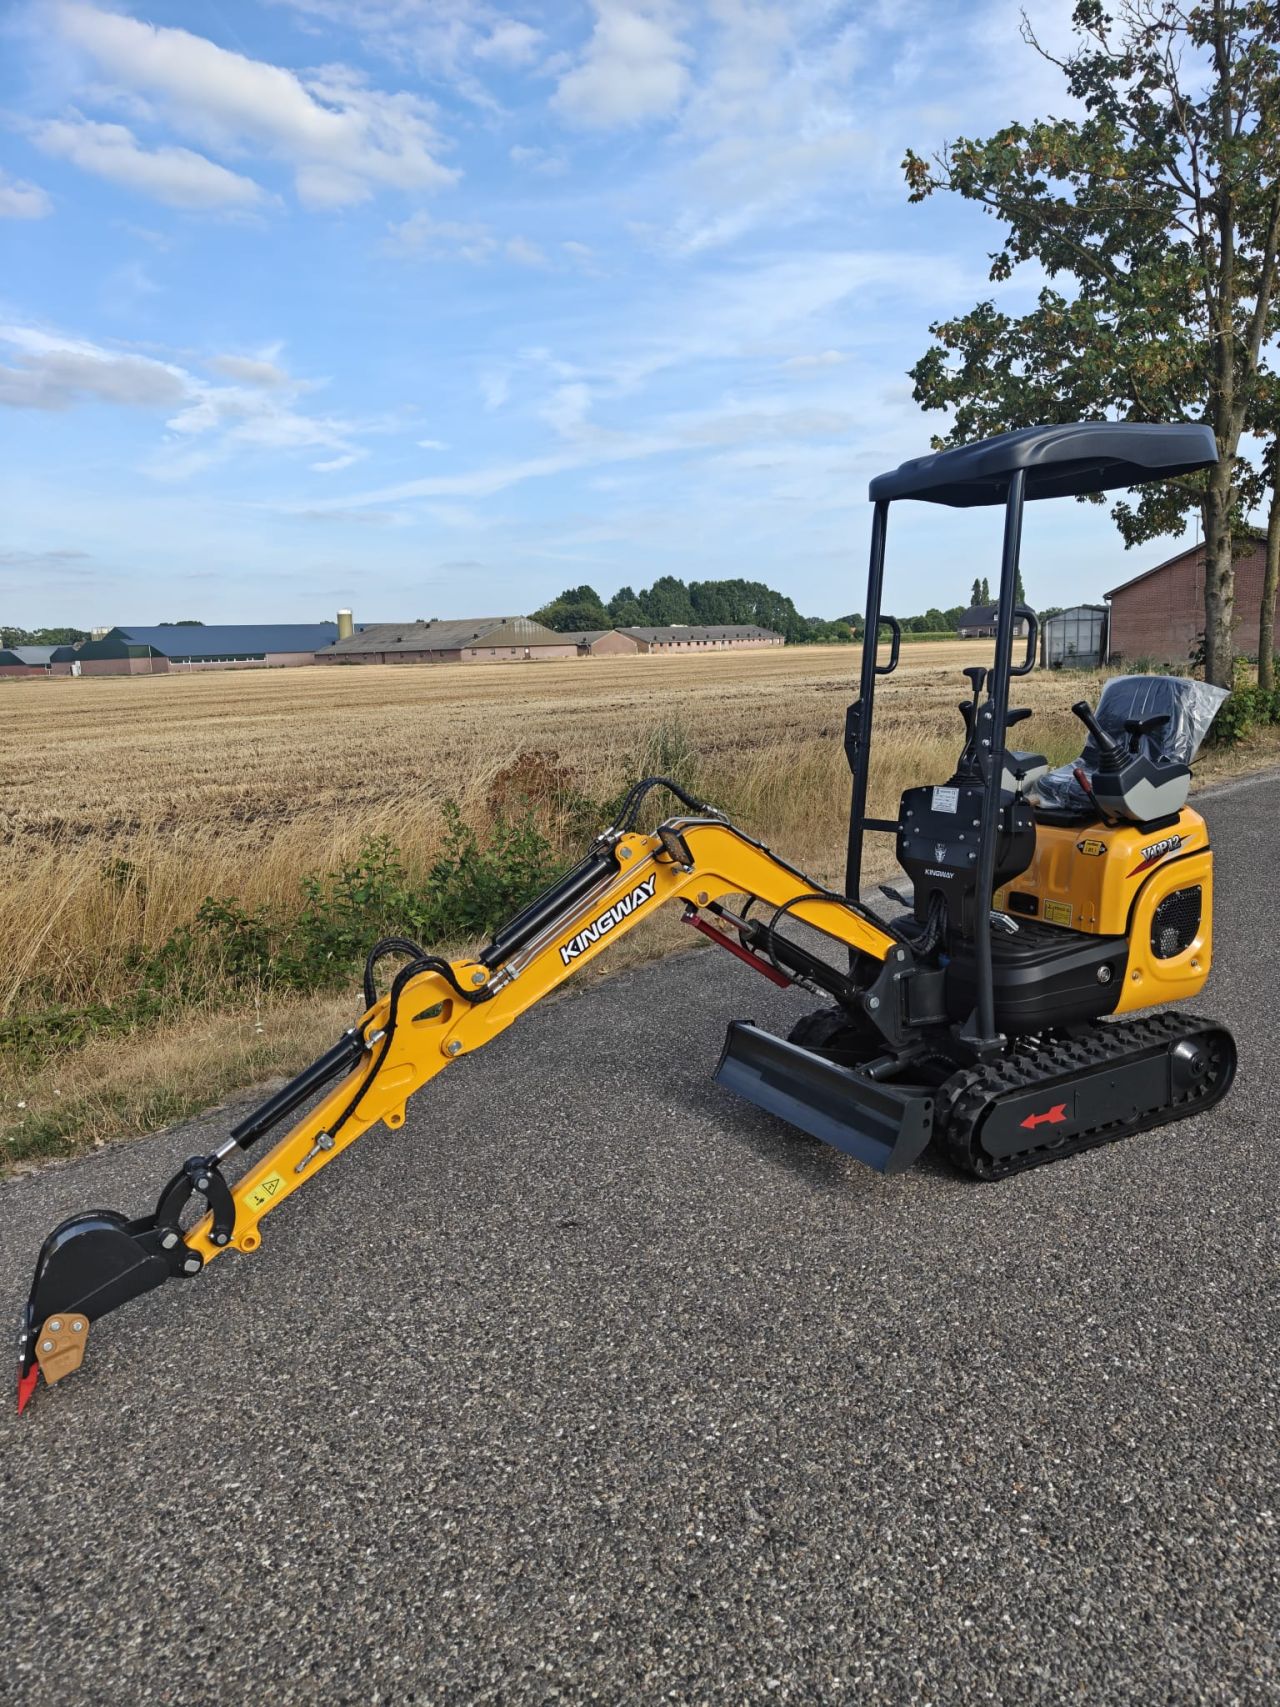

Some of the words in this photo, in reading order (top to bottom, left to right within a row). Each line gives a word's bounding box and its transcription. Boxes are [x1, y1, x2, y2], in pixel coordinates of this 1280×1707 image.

[1140, 835, 1181, 861] VIP12
[924, 868, 955, 879] KINGWAY
[559, 872, 656, 966] KINGWAY
